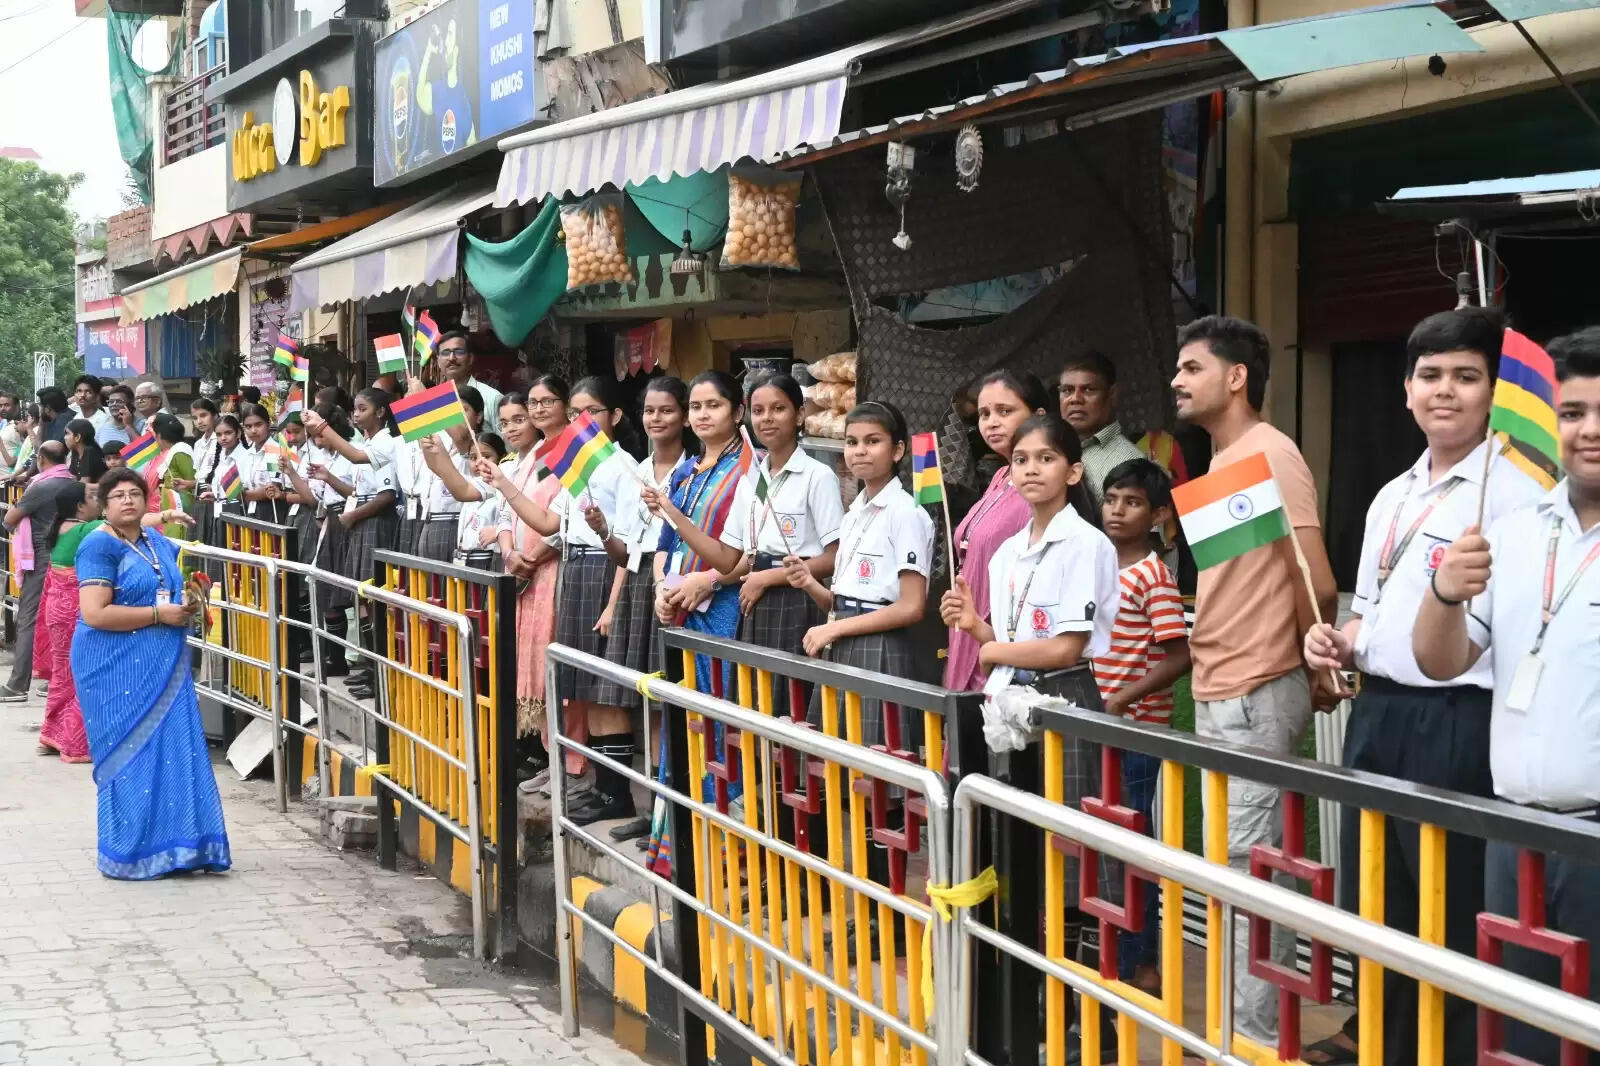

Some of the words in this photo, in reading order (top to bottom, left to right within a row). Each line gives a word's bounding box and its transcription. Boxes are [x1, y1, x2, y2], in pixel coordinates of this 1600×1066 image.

[490, 4, 510, 31] NEW
[490, 33, 523, 66] KHUSHI
[491, 70, 524, 102] MOMOS
[300, 69, 350, 168] Bar
